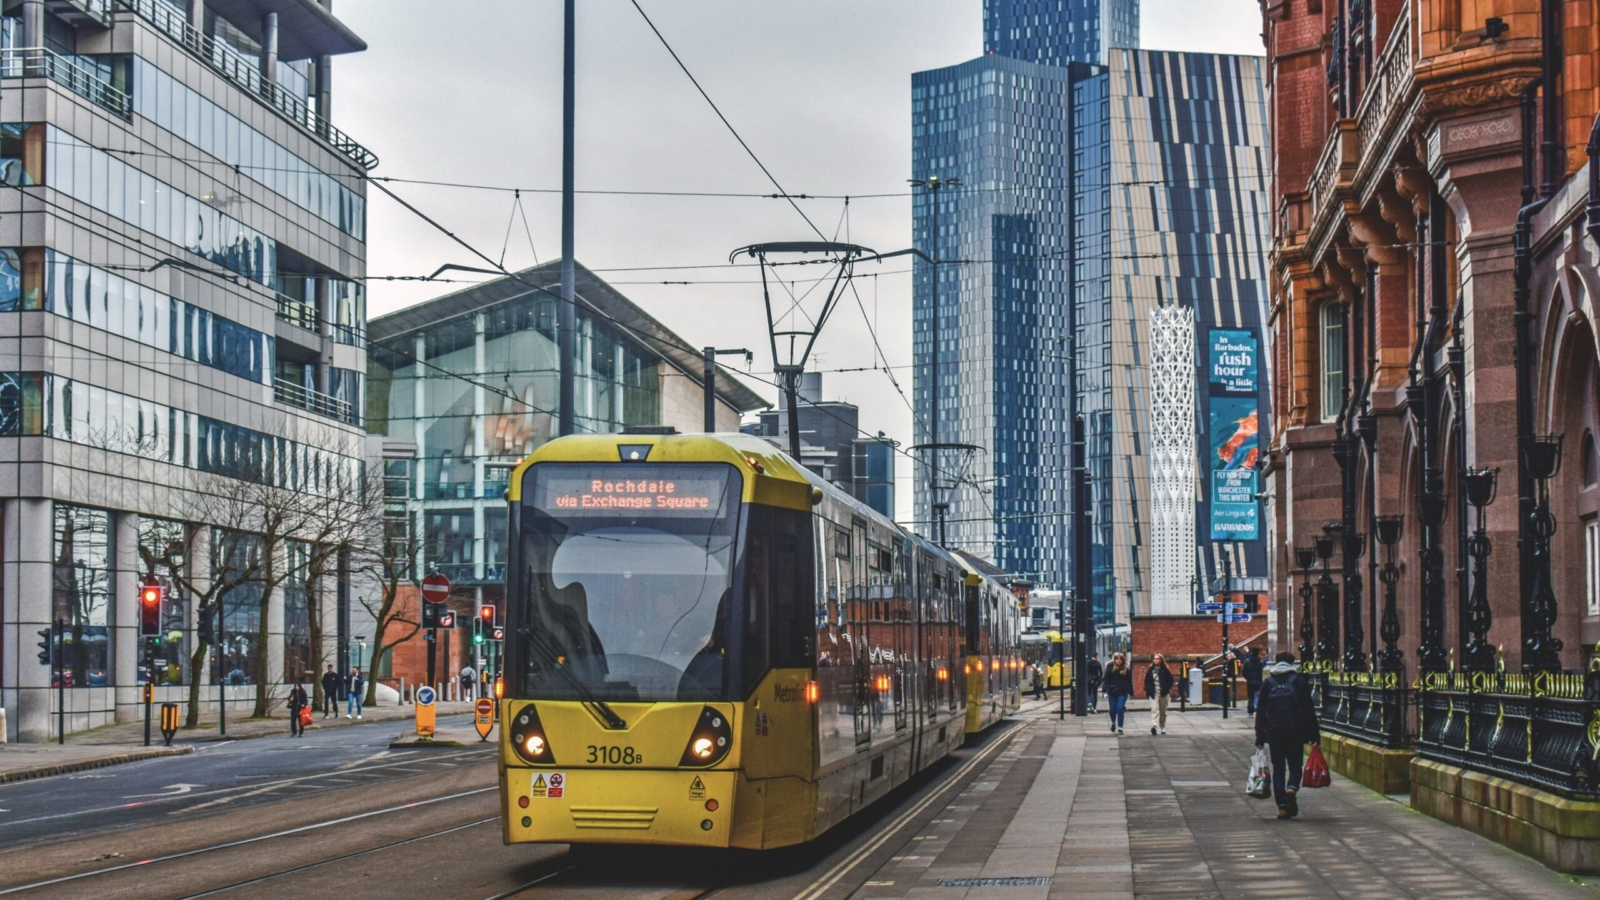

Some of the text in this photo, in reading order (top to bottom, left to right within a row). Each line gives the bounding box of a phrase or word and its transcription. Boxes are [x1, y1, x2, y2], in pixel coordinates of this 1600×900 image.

[1219, 352, 1252, 366] rush
[1214, 364, 1245, 376] hour
[592, 480, 675, 493] Rochdale
[1217, 486, 1251, 494] MANCHESTER
[556, 495, 709, 508] via Exchange Square
[1225, 510, 1246, 518] Lingus
[1214, 523, 1254, 531] BARBADOS
[774, 683, 808, 702] Metrolin
[586, 745, 642, 765] 3108B
